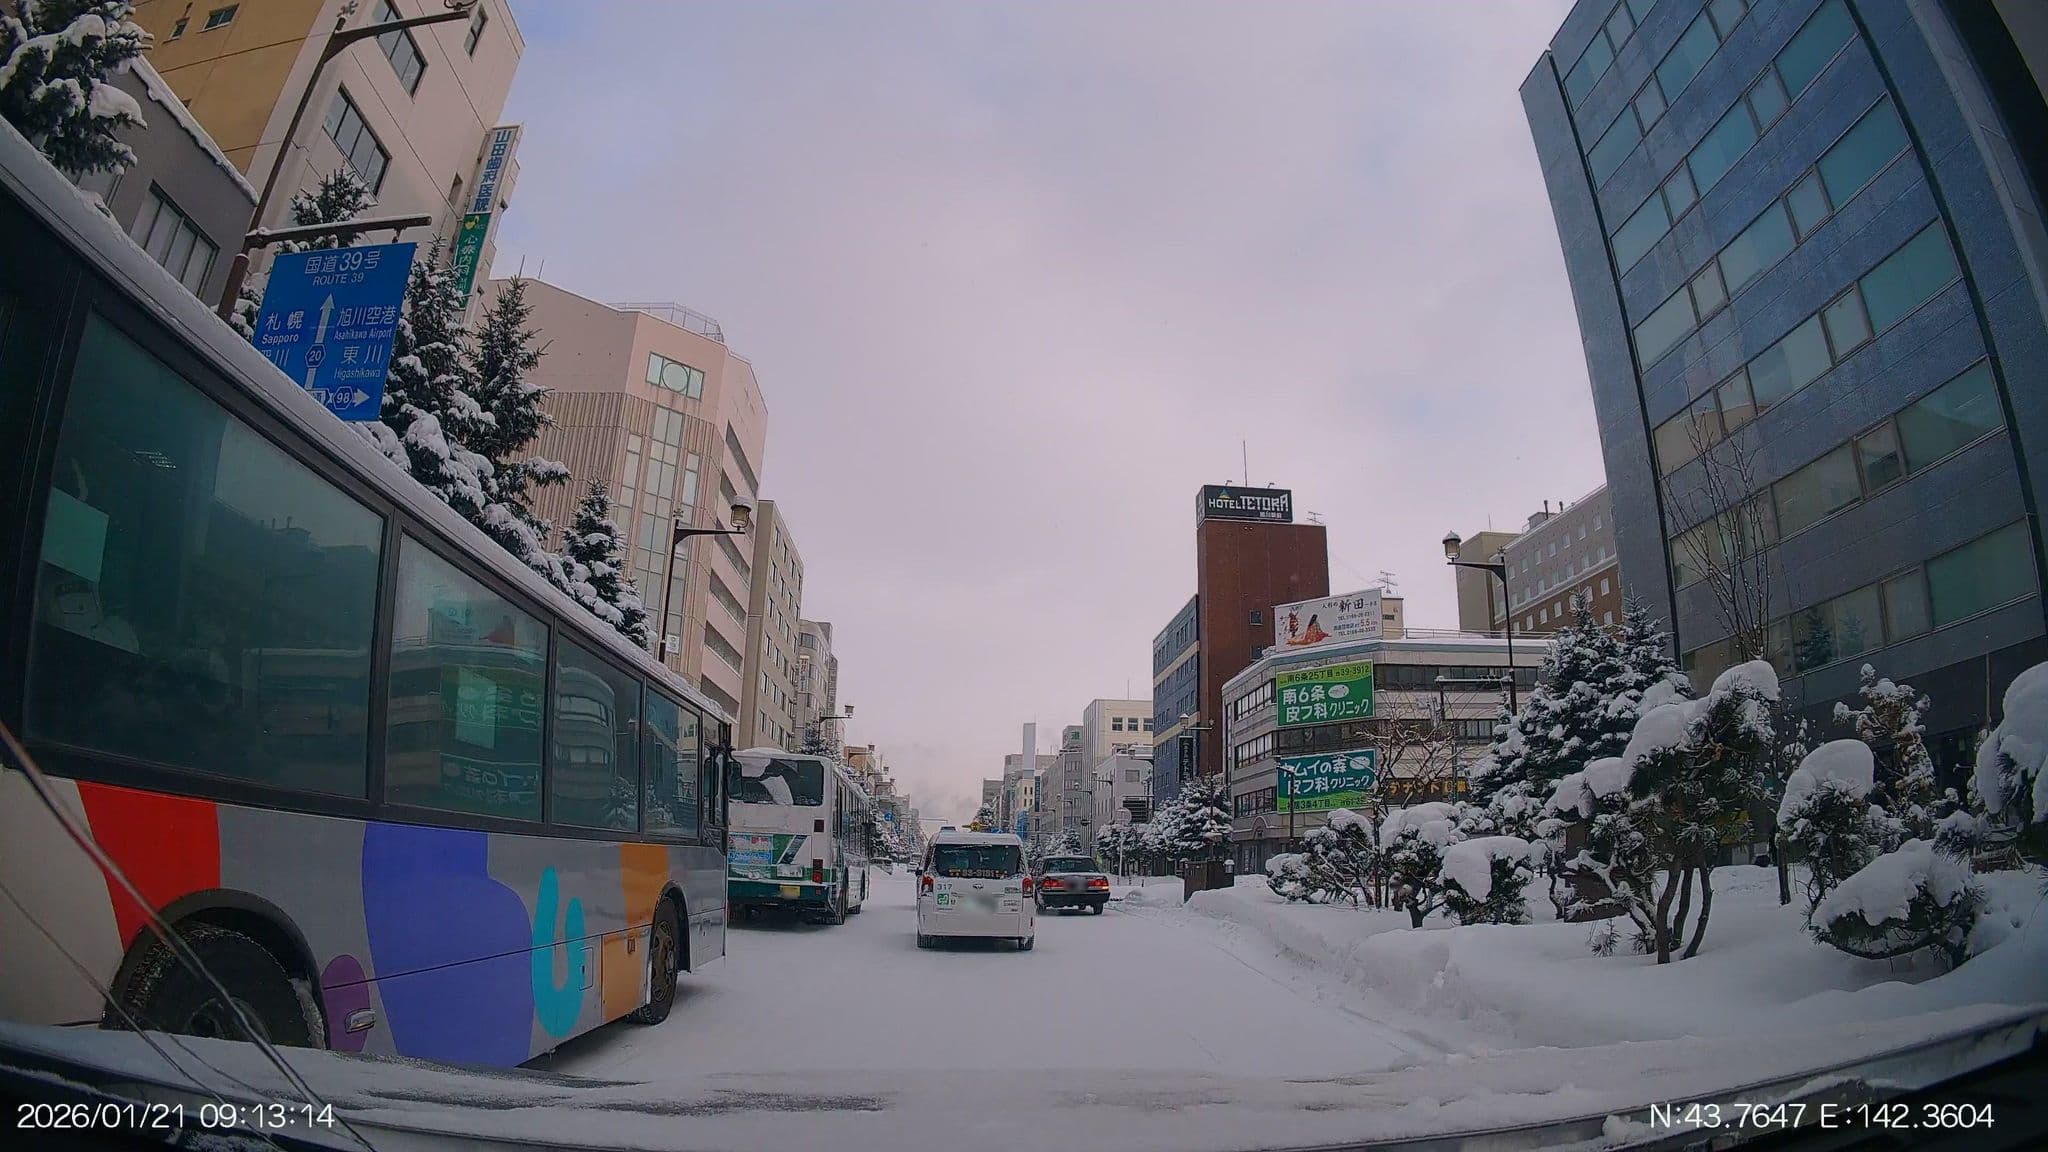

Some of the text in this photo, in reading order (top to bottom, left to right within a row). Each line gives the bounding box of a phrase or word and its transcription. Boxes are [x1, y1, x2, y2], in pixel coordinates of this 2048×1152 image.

[473, 130, 512, 212] 山田歯科医院
[304, 251, 381, 274] 国道39号
[313, 272, 364, 286] ROUTE 39
[337, 305, 397, 327] 旭川空港
[261, 333, 299, 345] Sapporo
[334, 328, 392, 341] Asahikawa Airport
[309, 351, 321, 361] 20
[334, 367, 381, 380] Higashikawa
[337, 391, 349, 402] 98
[1208, 494, 1288, 511] HOTEL TETORA
[1282, 685, 1325, 705] 南6条
[1286, 699, 1369, 723] 皮フ科クリニック
